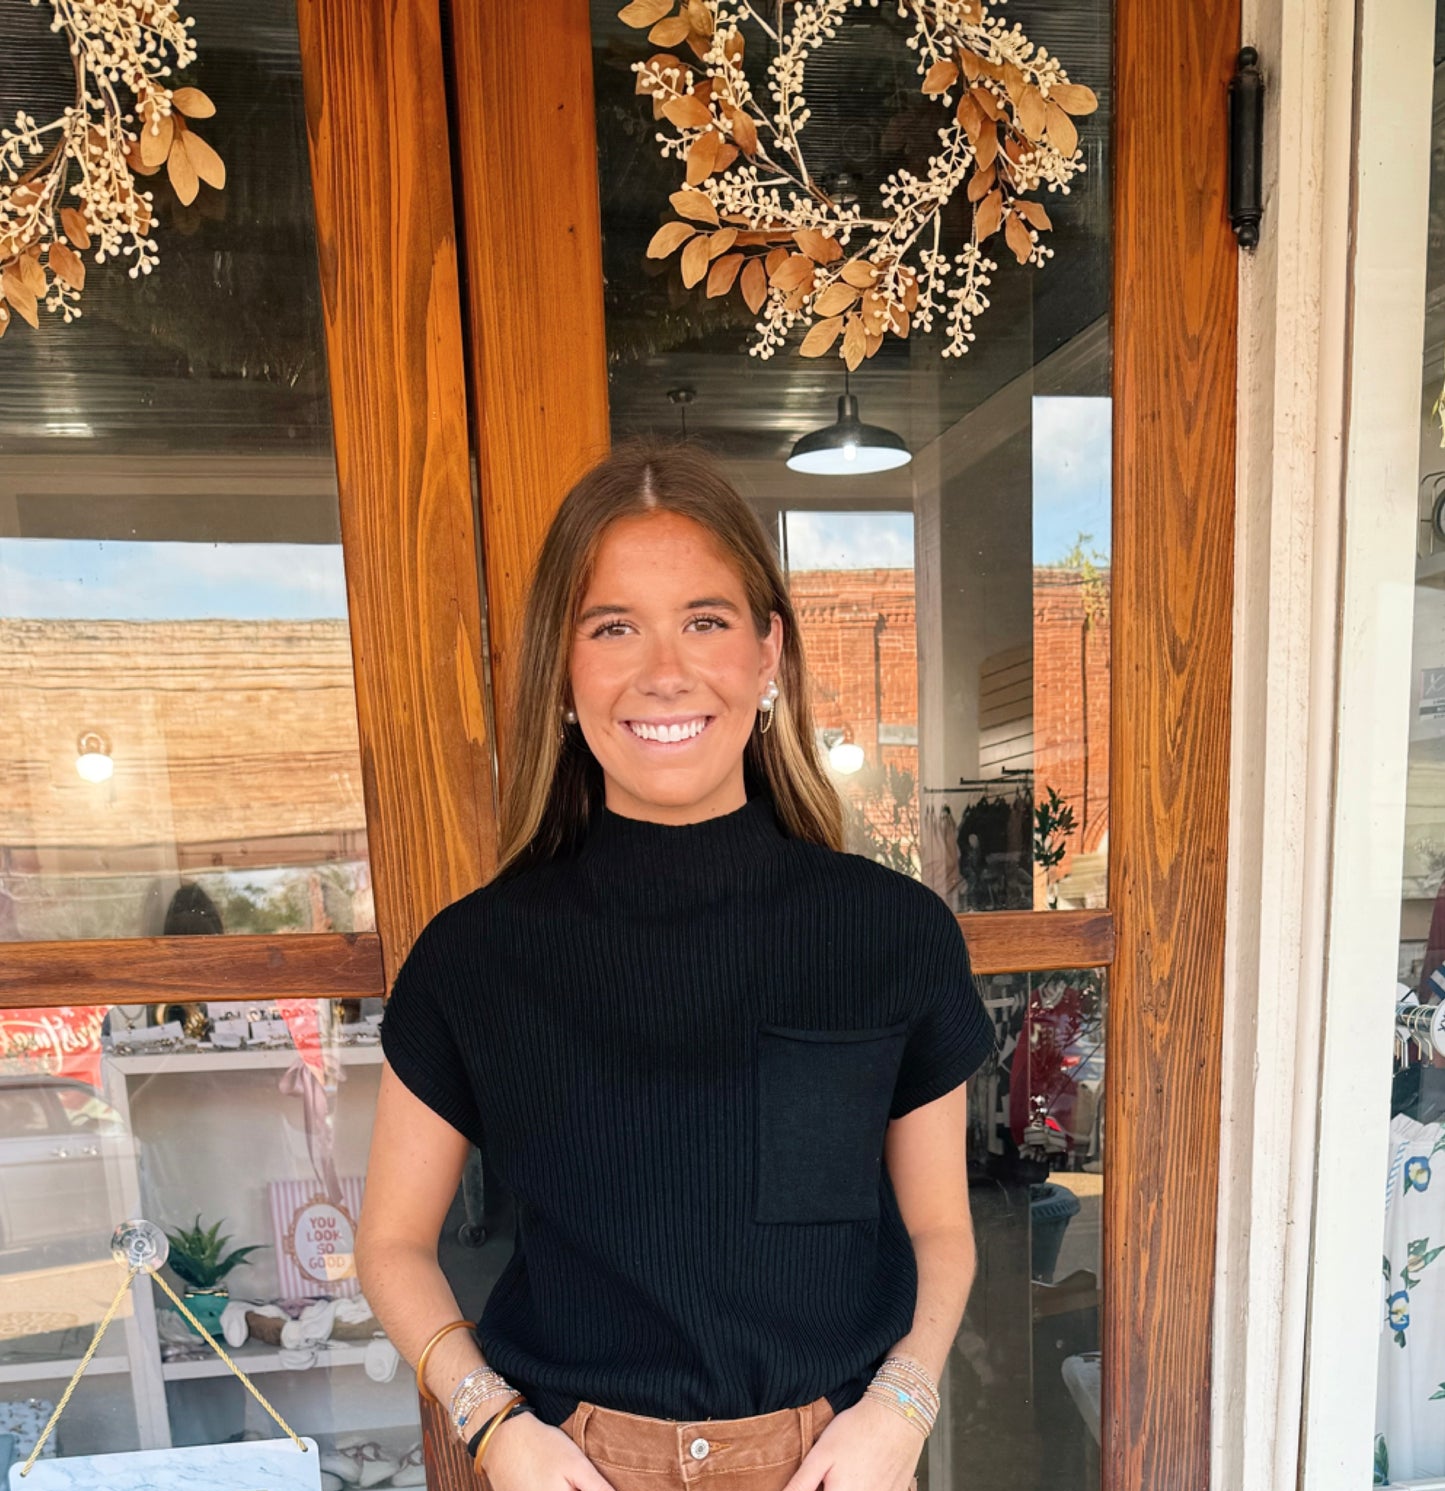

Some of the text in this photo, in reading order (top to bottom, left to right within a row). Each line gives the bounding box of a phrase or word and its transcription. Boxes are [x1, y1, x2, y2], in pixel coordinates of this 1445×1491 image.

[310, 1216, 336, 1229] YOU
[306, 1230, 342, 1242] LOOK
[316, 1243, 335, 1255] SO
[309, 1257, 345, 1269] GOOD
